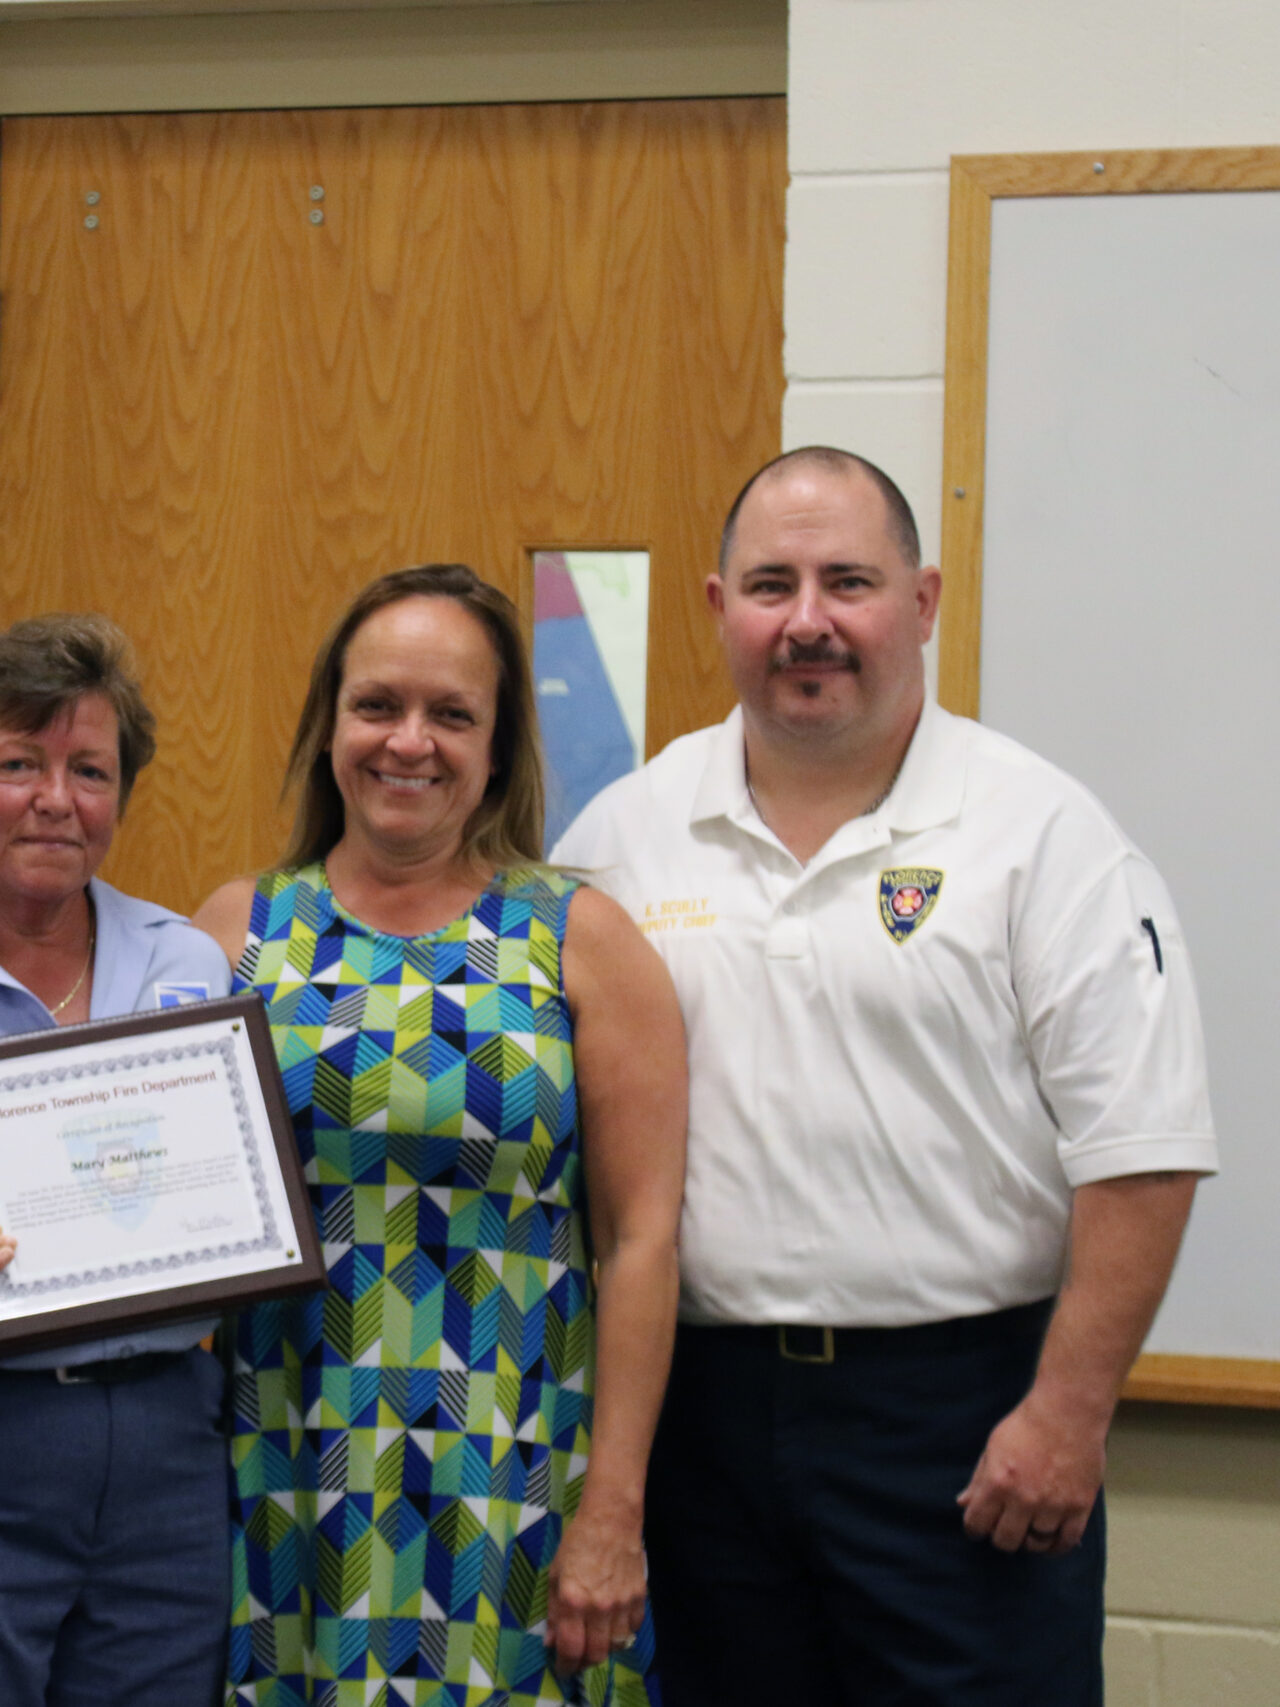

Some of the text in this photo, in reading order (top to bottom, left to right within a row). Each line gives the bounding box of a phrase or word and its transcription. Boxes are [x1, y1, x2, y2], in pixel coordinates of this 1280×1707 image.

[51, 1091, 110, 1110] Township
[113, 1085, 138, 1099] Fire
[142, 1070, 217, 1093] Department
[70, 1147, 168, 1173] Mary Matthews
